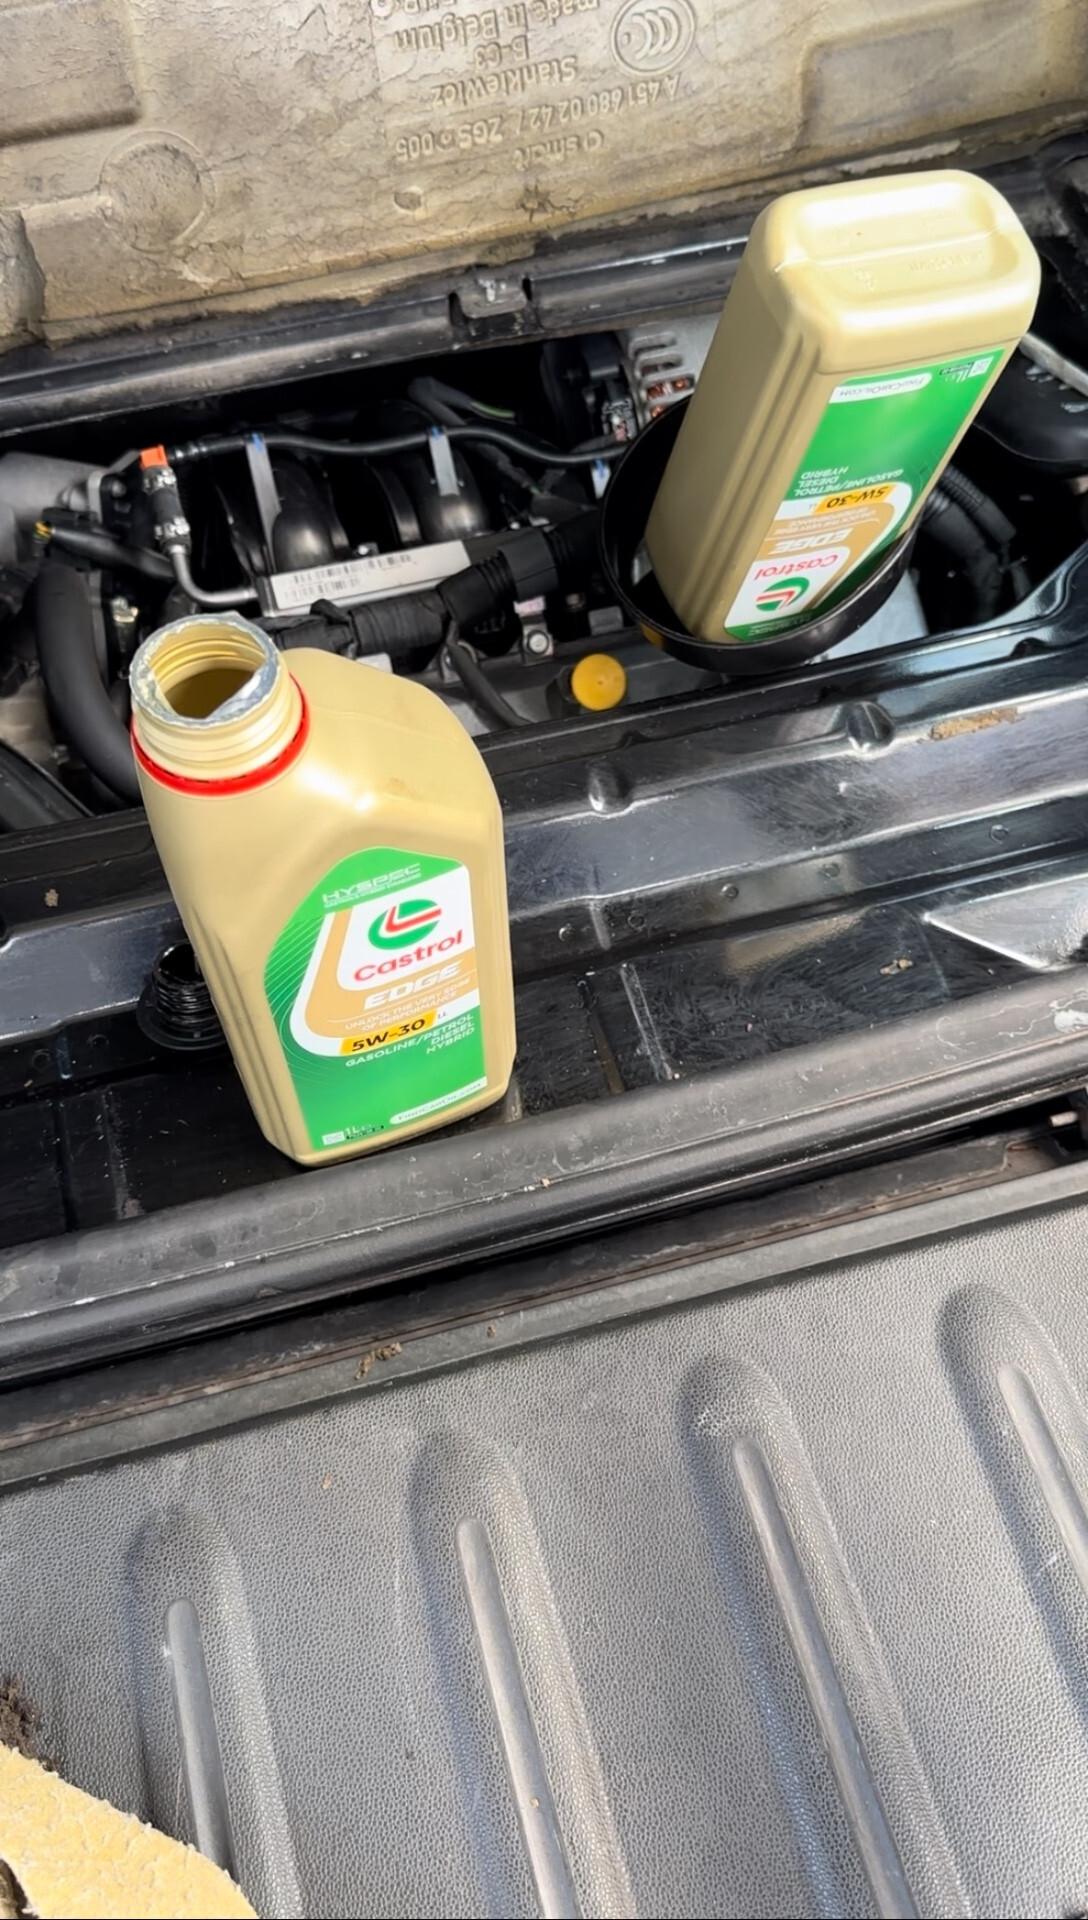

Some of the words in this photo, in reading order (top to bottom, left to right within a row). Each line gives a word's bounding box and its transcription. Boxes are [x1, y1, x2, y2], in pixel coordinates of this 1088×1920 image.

[506, 2, 529, 31] in
[533, 0, 599, 27] made
[394, 9, 499, 51] Belgium
[627, 76, 660, 107] 451
[664, 72, 681, 99] A
[558, 97, 585, 123] 02
[587, 86, 623, 116] 680
[528, 102, 554, 130] 42
[396, 130, 437, 162] 005
[458, 115, 503, 150] ZGS
[513, 135, 581, 172] smart
[794, 468, 904, 497] GASOLINE/PETROL
[797, 476, 840, 489] DIESEL
[801, 466, 849, 480] HYBRID
[826, 485, 889, 509] 5W-30
[768, 528, 853, 554] EDGE
[754, 553, 838, 581] Castrol
[353, 929, 463, 982] Castrol
[364, 959, 463, 1010] EDGE
[345, 1013, 474, 1067] GASOLINE/PETROL
[352, 1018, 425, 1052] 5W-30
[426, 1028, 475, 1054] HYBRID
[431, 1021, 475, 1046] DIESEL
